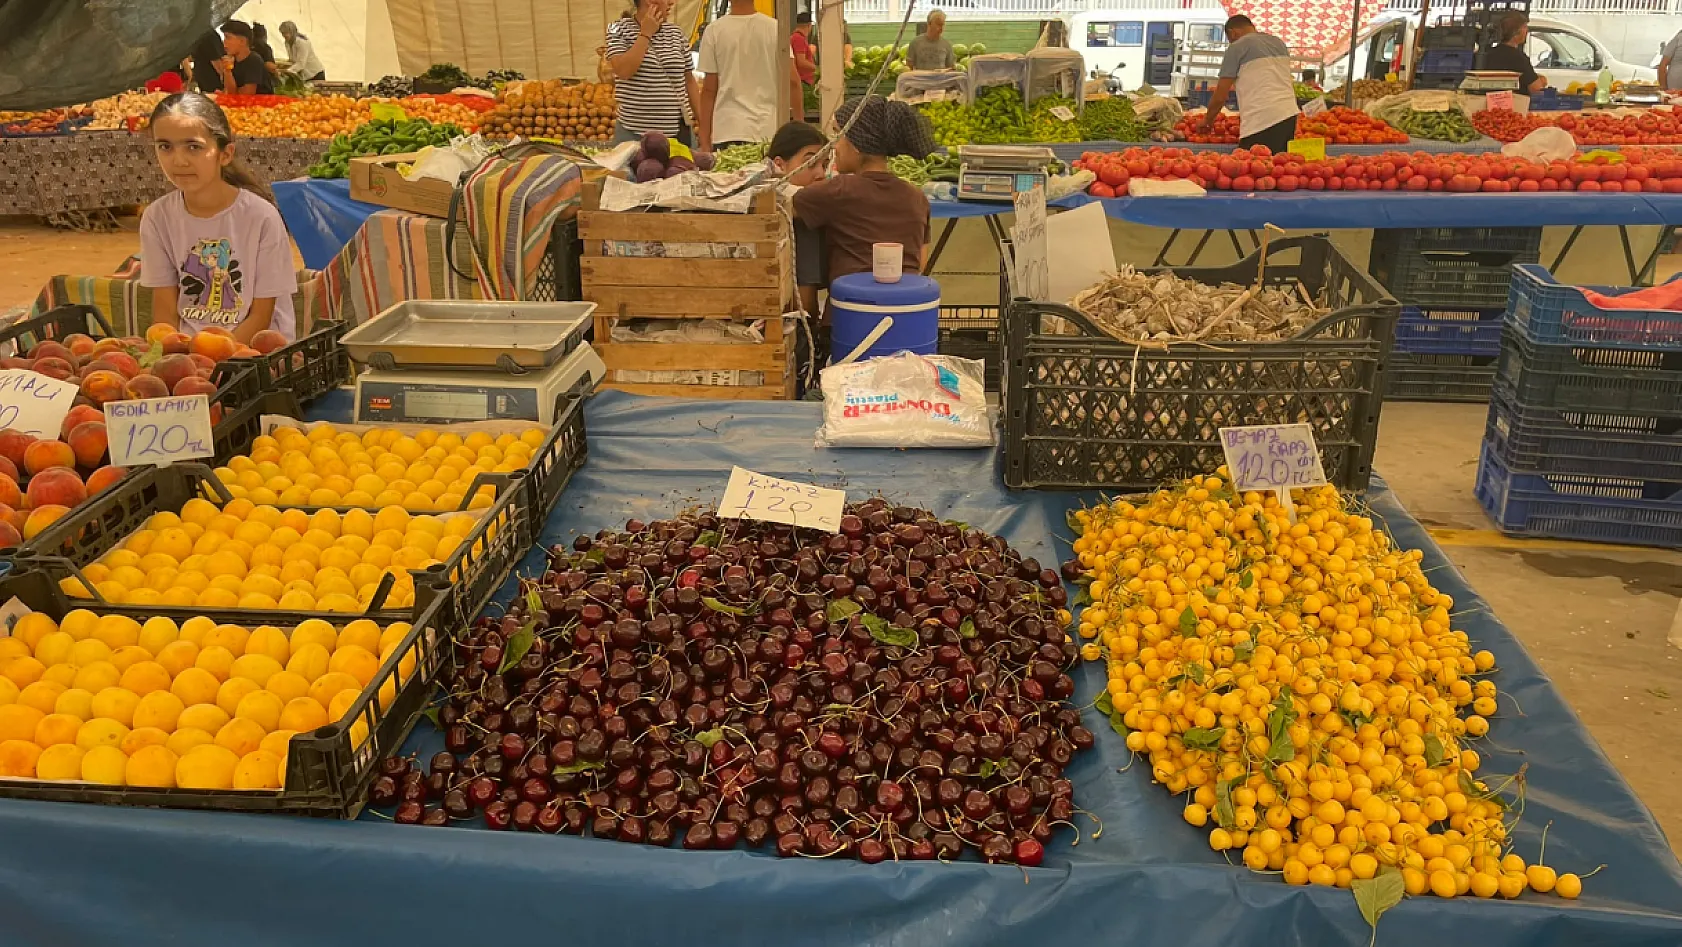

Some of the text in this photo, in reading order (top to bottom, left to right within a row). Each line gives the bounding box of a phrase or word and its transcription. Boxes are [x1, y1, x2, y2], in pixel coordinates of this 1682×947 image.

[182, 307, 209, 320] STAY
[126, 424, 188, 460] 120
[1236, 450, 1290, 487] 120
[735, 489, 813, 513] 120
